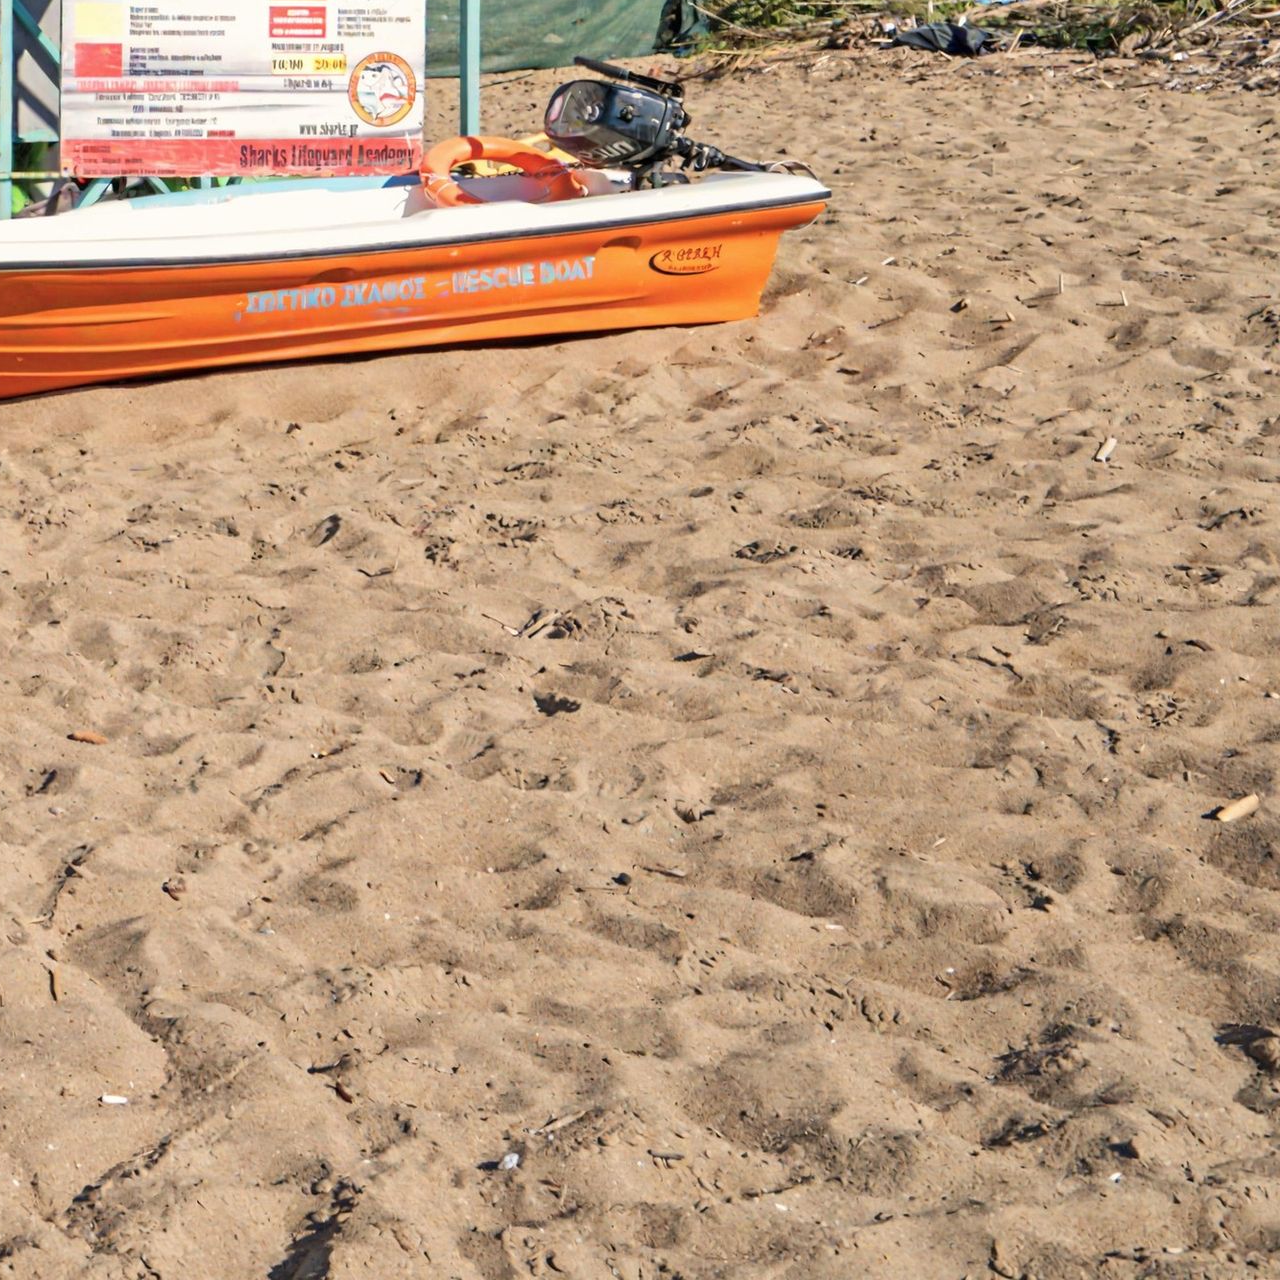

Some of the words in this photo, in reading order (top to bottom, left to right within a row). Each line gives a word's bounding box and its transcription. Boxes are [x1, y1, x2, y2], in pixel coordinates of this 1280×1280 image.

[240, 144, 287, 168] Sharks
[291, 145, 353, 170] Lifeguard
[357, 145, 414, 169] Academy
[452, 263, 535, 294] RESCUE
